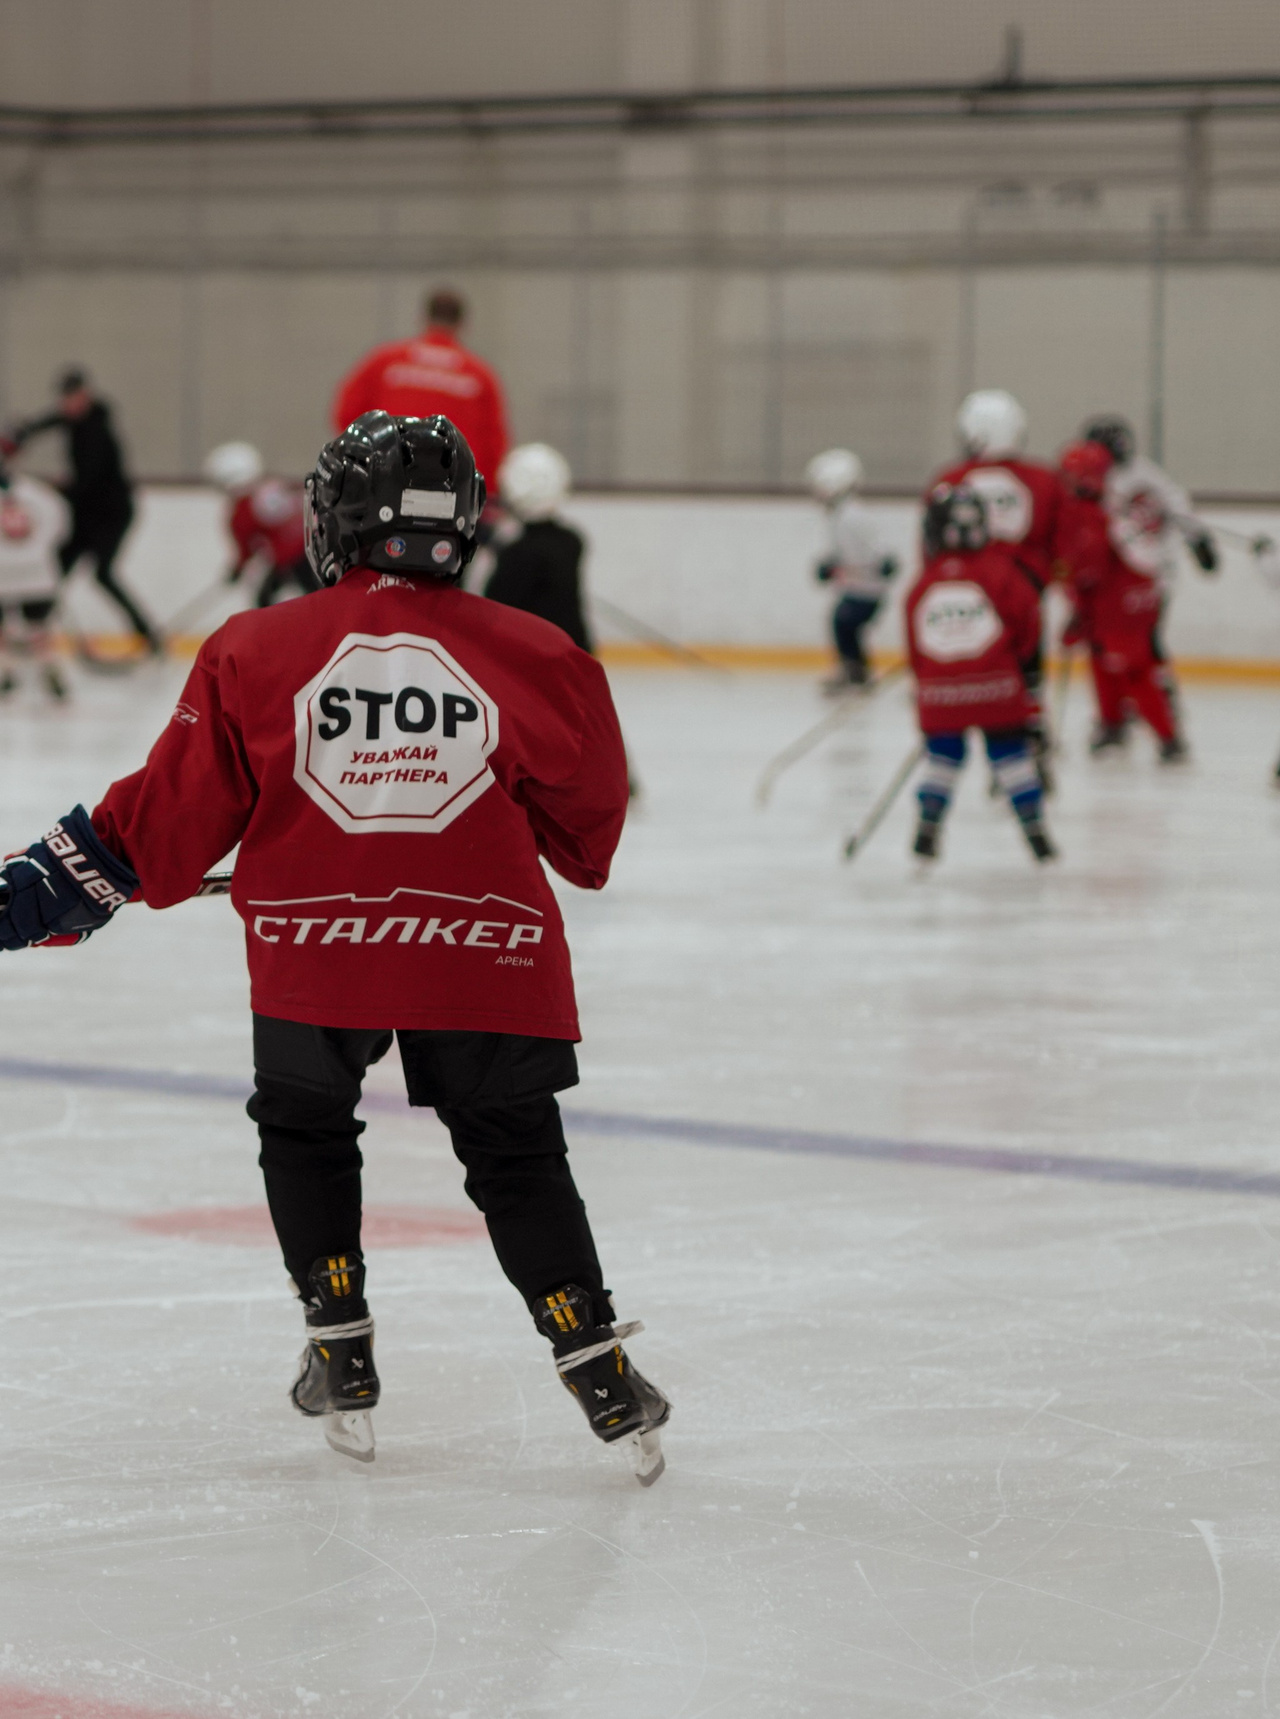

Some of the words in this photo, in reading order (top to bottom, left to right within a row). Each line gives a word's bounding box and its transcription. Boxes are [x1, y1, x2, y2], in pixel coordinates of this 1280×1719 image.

[318, 686, 479, 741] STOP
[349, 744, 439, 765] УВАЖАЙ
[338, 768, 449, 785] ПАРТНЕРА
[253, 914, 544, 949] СТАЛКЕР
[494, 955, 535, 968] АРЕНА
